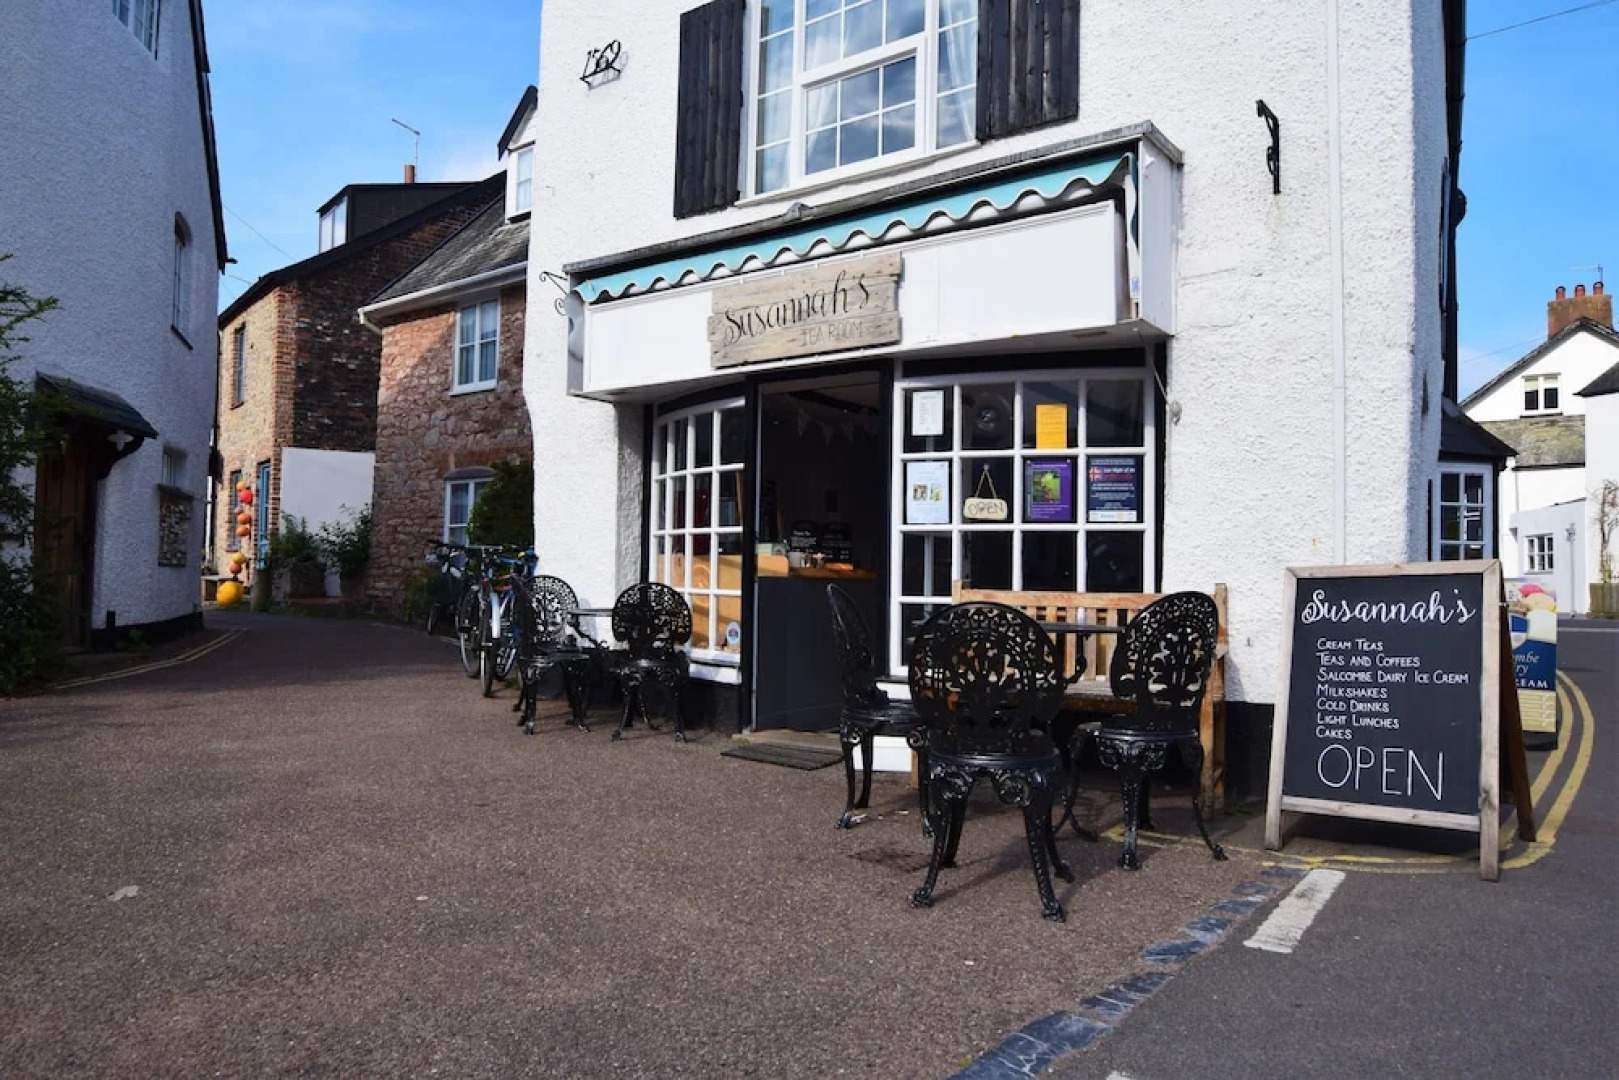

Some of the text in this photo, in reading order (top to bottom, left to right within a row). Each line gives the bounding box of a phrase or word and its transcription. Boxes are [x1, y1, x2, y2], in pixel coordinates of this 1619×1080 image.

[723, 269, 870, 348] Susannah's
[800, 319, 863, 346] TEA ROOM
[967, 501, 1005, 517] OPEN
[1301, 588, 1477, 625] Susannah's
[1349, 655, 1372, 668] AND
[1317, 744, 1444, 801] OPEN
